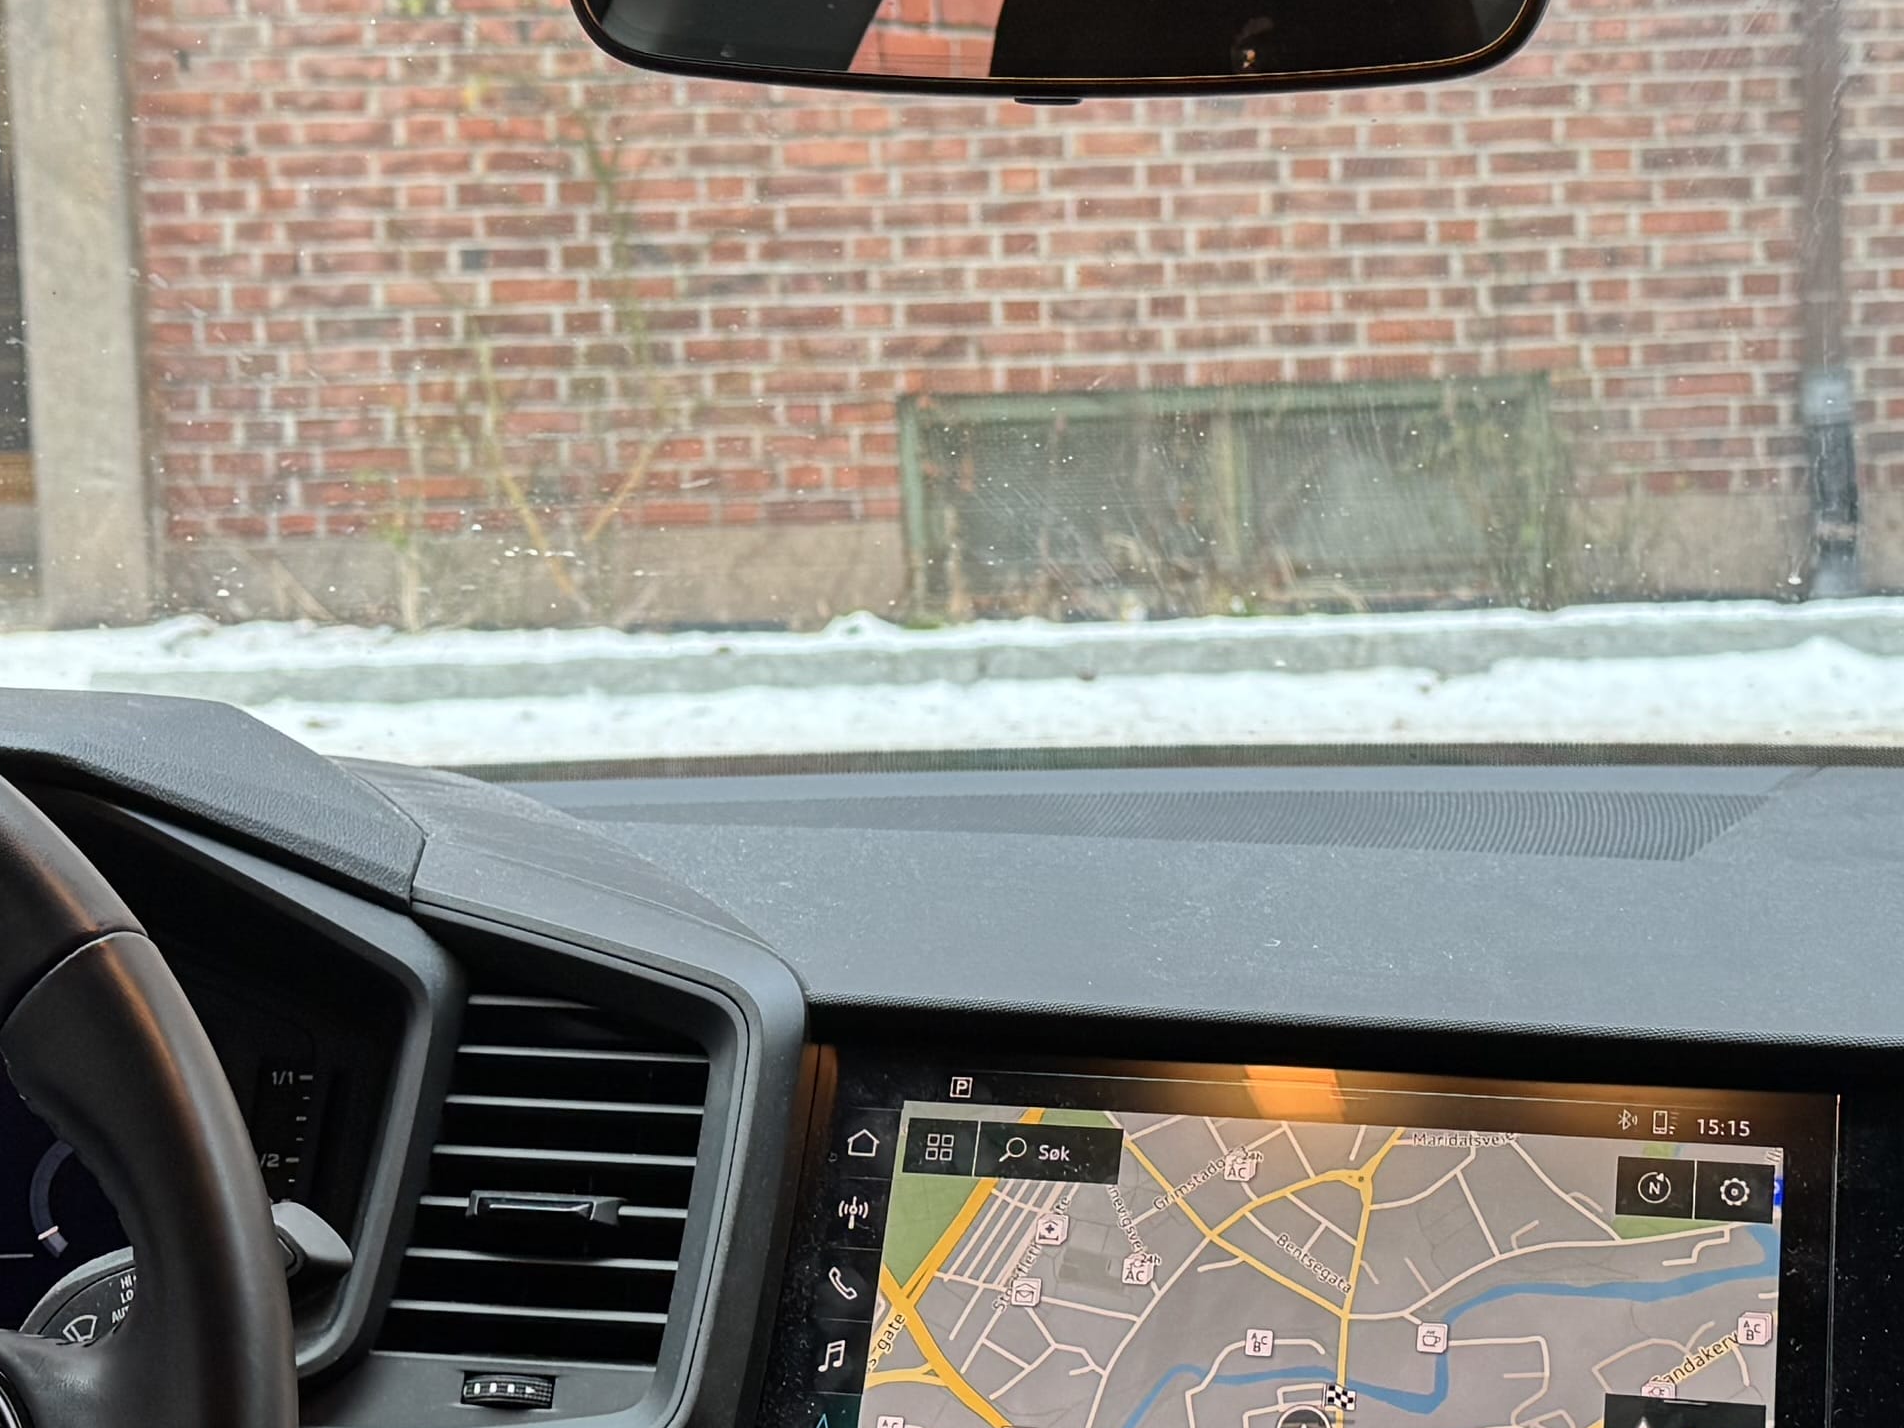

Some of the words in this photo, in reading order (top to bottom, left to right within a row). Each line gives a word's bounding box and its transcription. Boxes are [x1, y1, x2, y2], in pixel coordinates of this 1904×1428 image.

[271, 1071, 294, 1085] 1/1
[1696, 1118, 1751, 1138] 15:15
[1038, 1145, 1070, 1163] Søk
[1276, 1234, 1352, 1294] Bentsegata
[877, 1314, 906, 1352] gate
